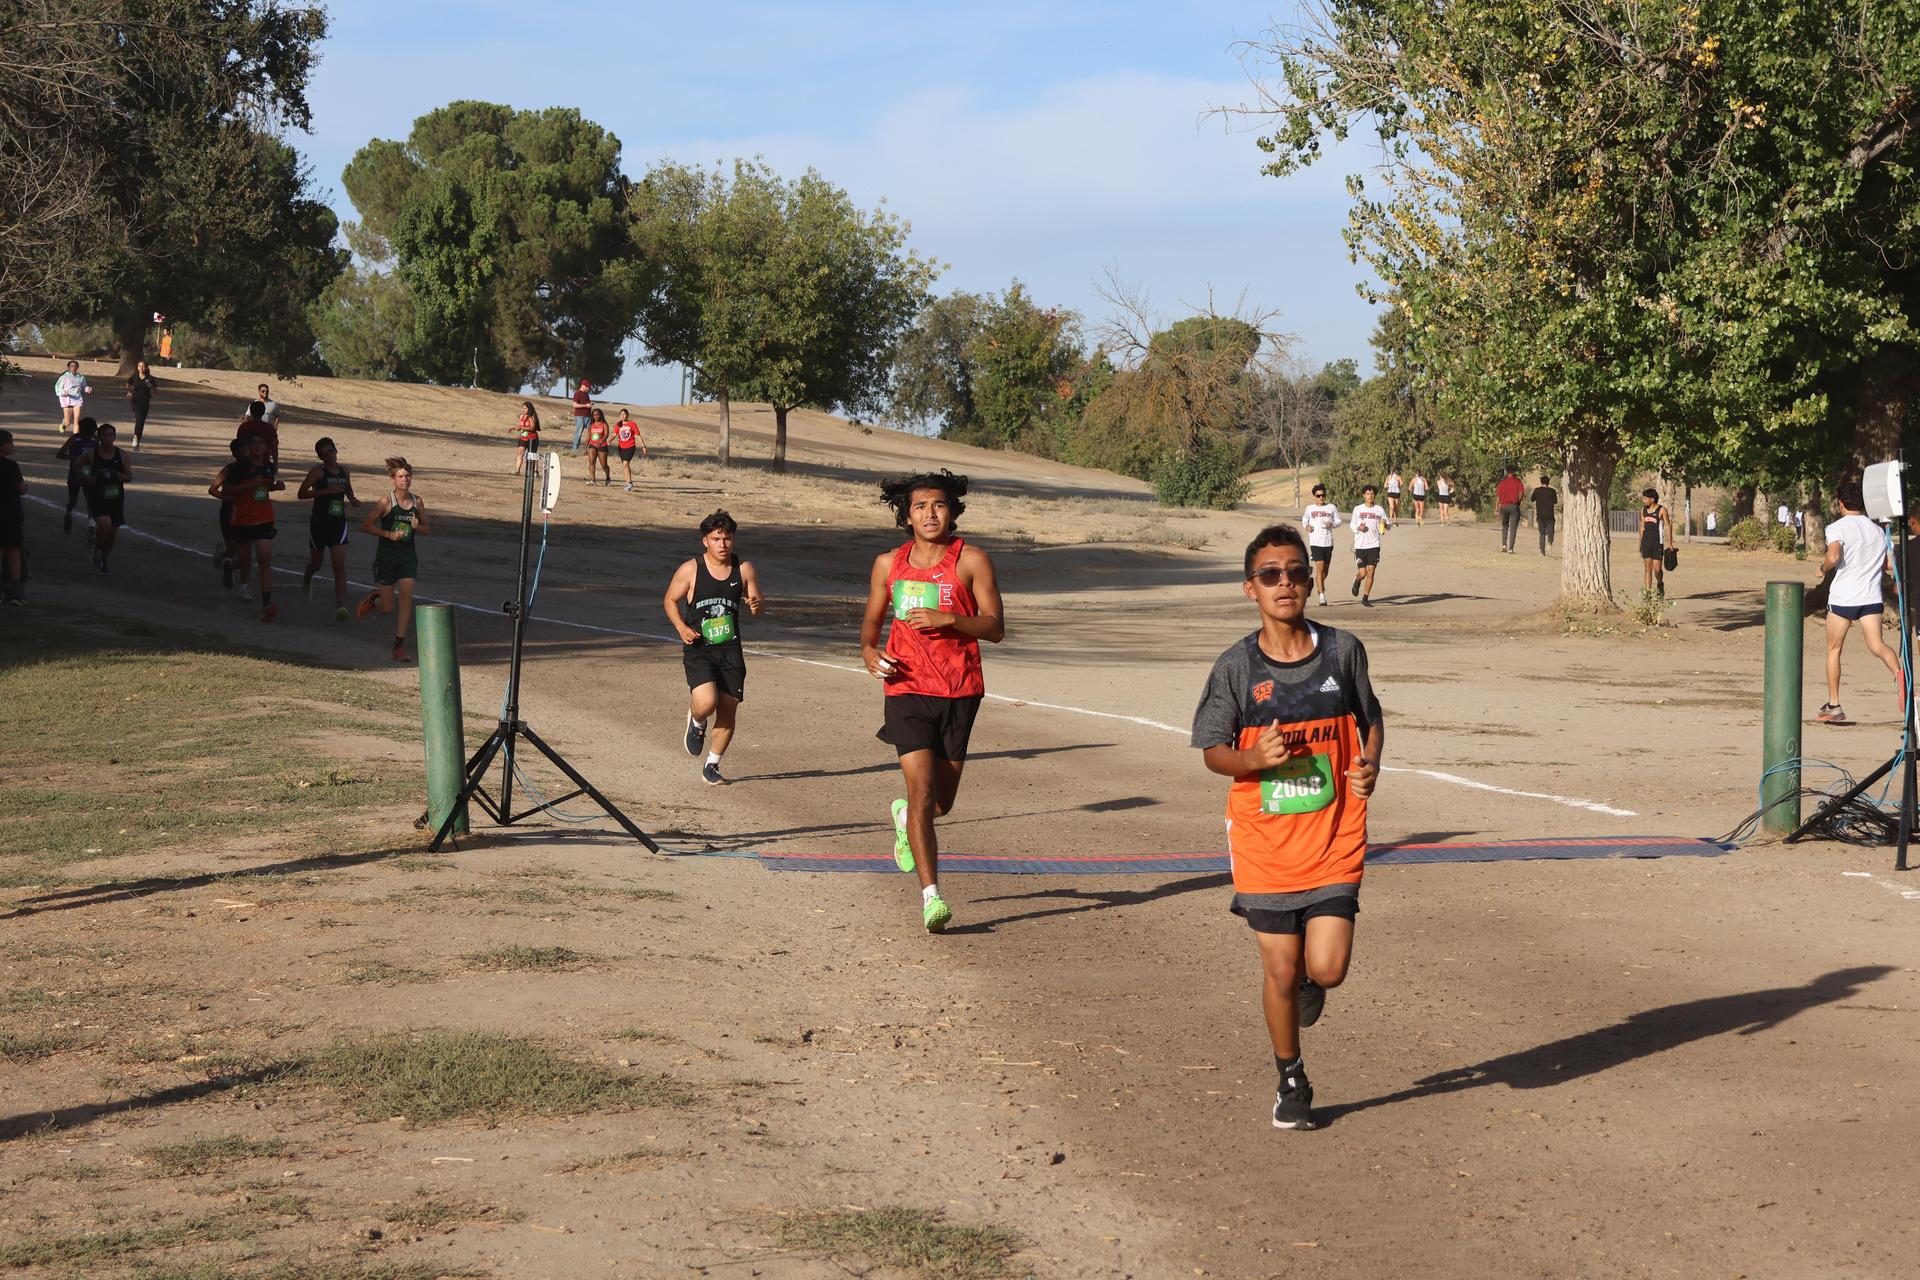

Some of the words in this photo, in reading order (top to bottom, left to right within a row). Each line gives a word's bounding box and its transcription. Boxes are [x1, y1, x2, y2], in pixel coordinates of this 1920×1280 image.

[900, 595, 924, 609] 291
[708, 624, 730, 638] 1375
[1320, 684, 1340, 692] adidas
[1270, 775, 1321, 799] 2068
